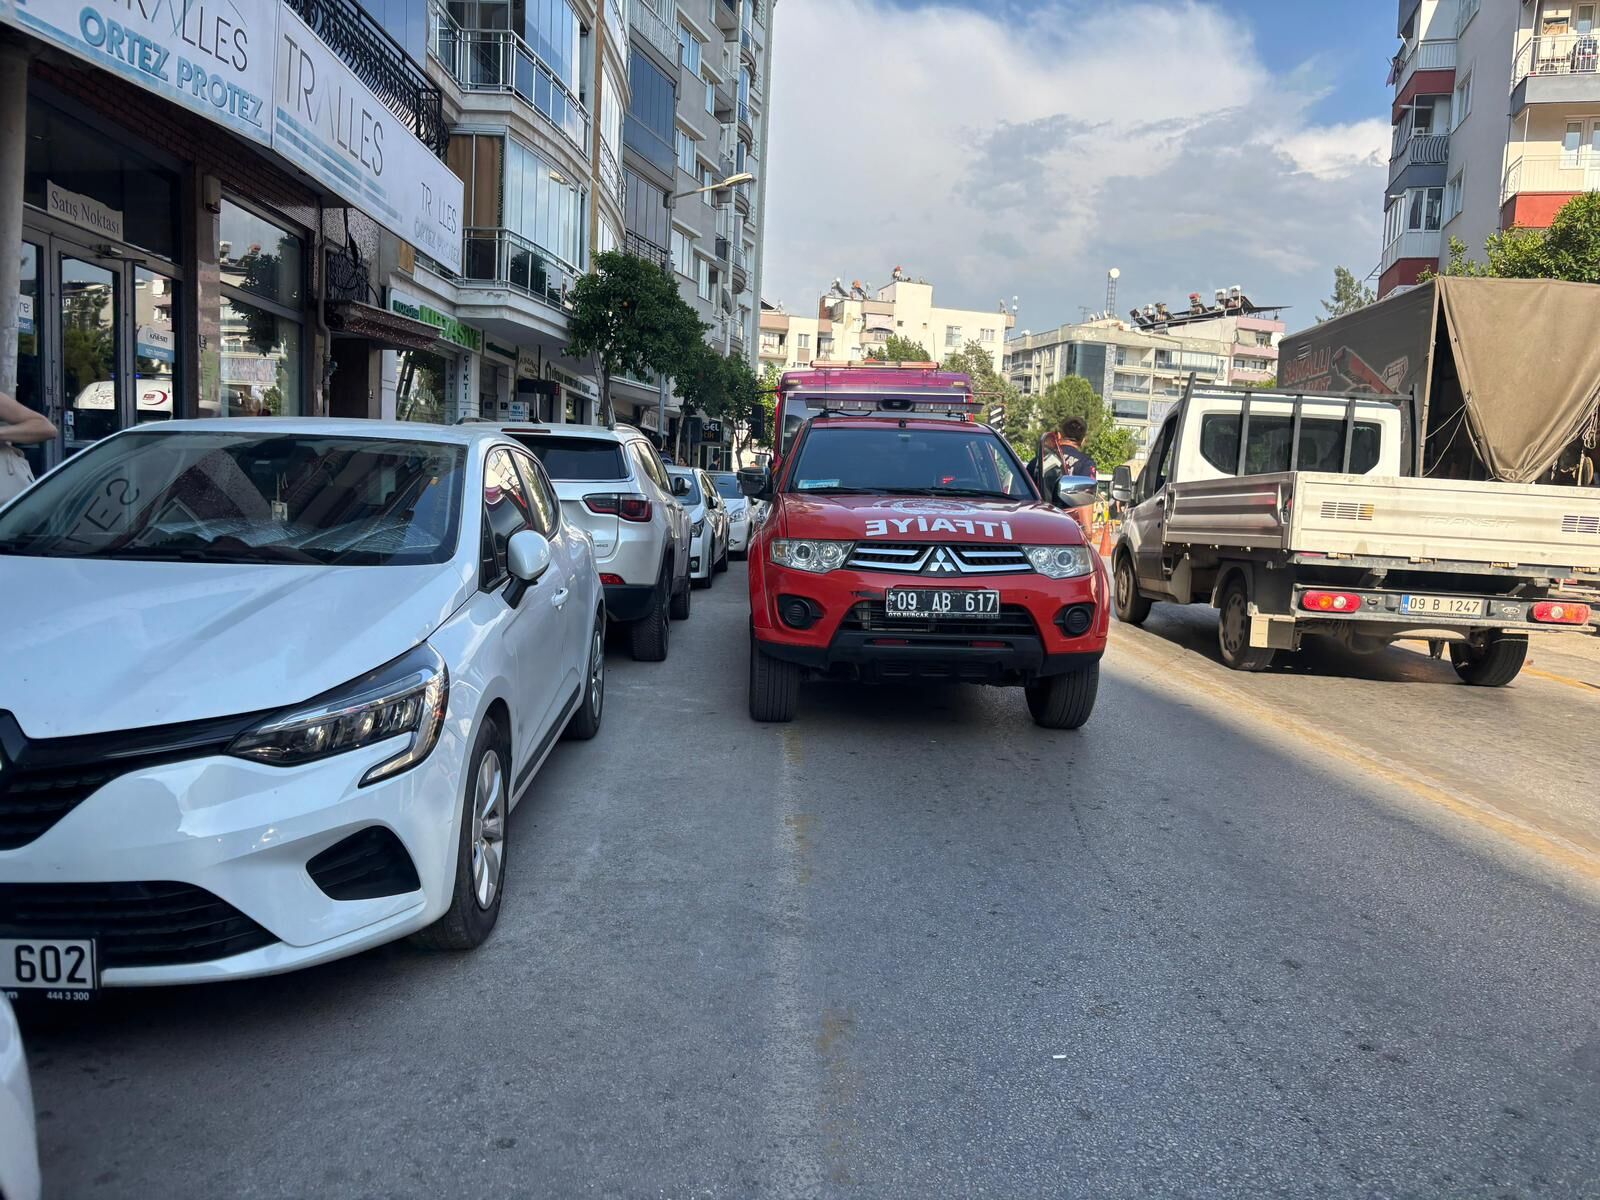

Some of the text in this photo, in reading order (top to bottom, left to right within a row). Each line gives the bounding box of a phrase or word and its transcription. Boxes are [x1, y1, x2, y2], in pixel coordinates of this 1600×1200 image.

[79, 6, 263, 128] ORTEZ PROTEZ
[284, 33, 385, 177] TRALLES
[51, 190, 120, 235] Satış Noktası
[421, 181, 457, 235] TRLLES
[897, 592, 995, 612] 09 AB 617
[1410, 597, 1480, 613] 09 B 1247
[15, 944, 87, 984] 602
[47, 991, 90, 1000] 444 3 300
